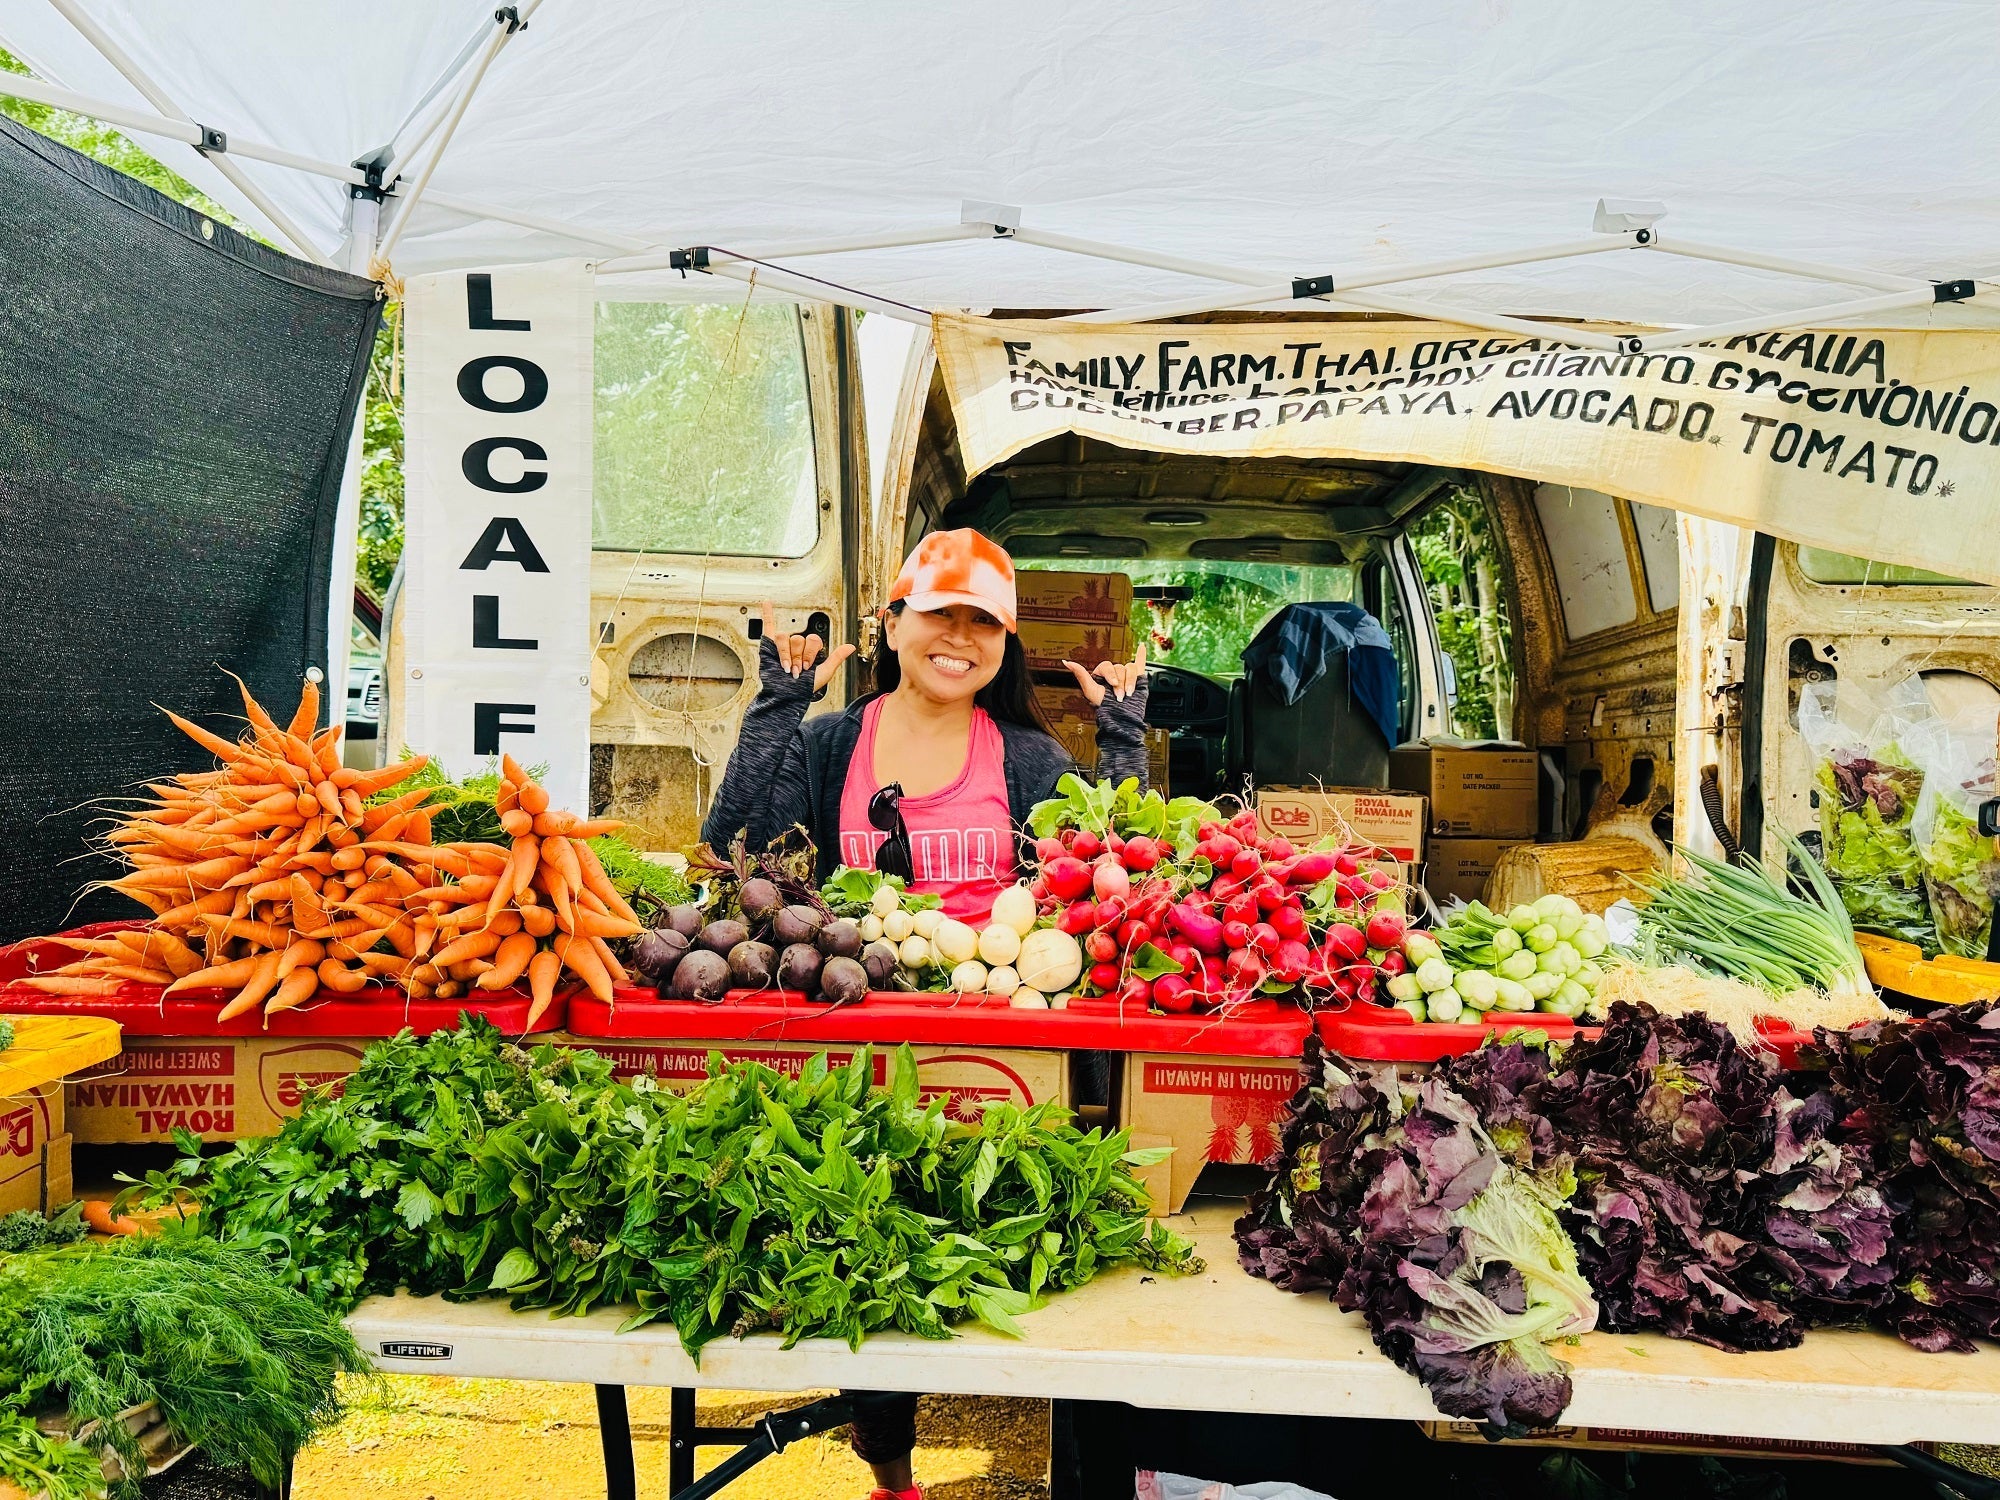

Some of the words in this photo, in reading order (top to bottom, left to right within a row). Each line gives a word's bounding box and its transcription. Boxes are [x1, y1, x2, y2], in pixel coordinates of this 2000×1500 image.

[456, 273, 551, 651] LOCAL
[1354, 798, 1391, 808] ROYAL
[1271, 807, 1310, 823] Dole
[839, 828, 998, 882] PMA
[167, 1052, 221, 1070] SWEET
[618, 1053, 658, 1071] WITH
[1155, 1068, 1213, 1089] HAWAII
[1218, 1071, 1236, 1090] IN
[1239, 1072, 1293, 1093] ALOHA
[135, 1109, 235, 1134] ROYAL
[389, 1345, 444, 1357] LIFETIME
